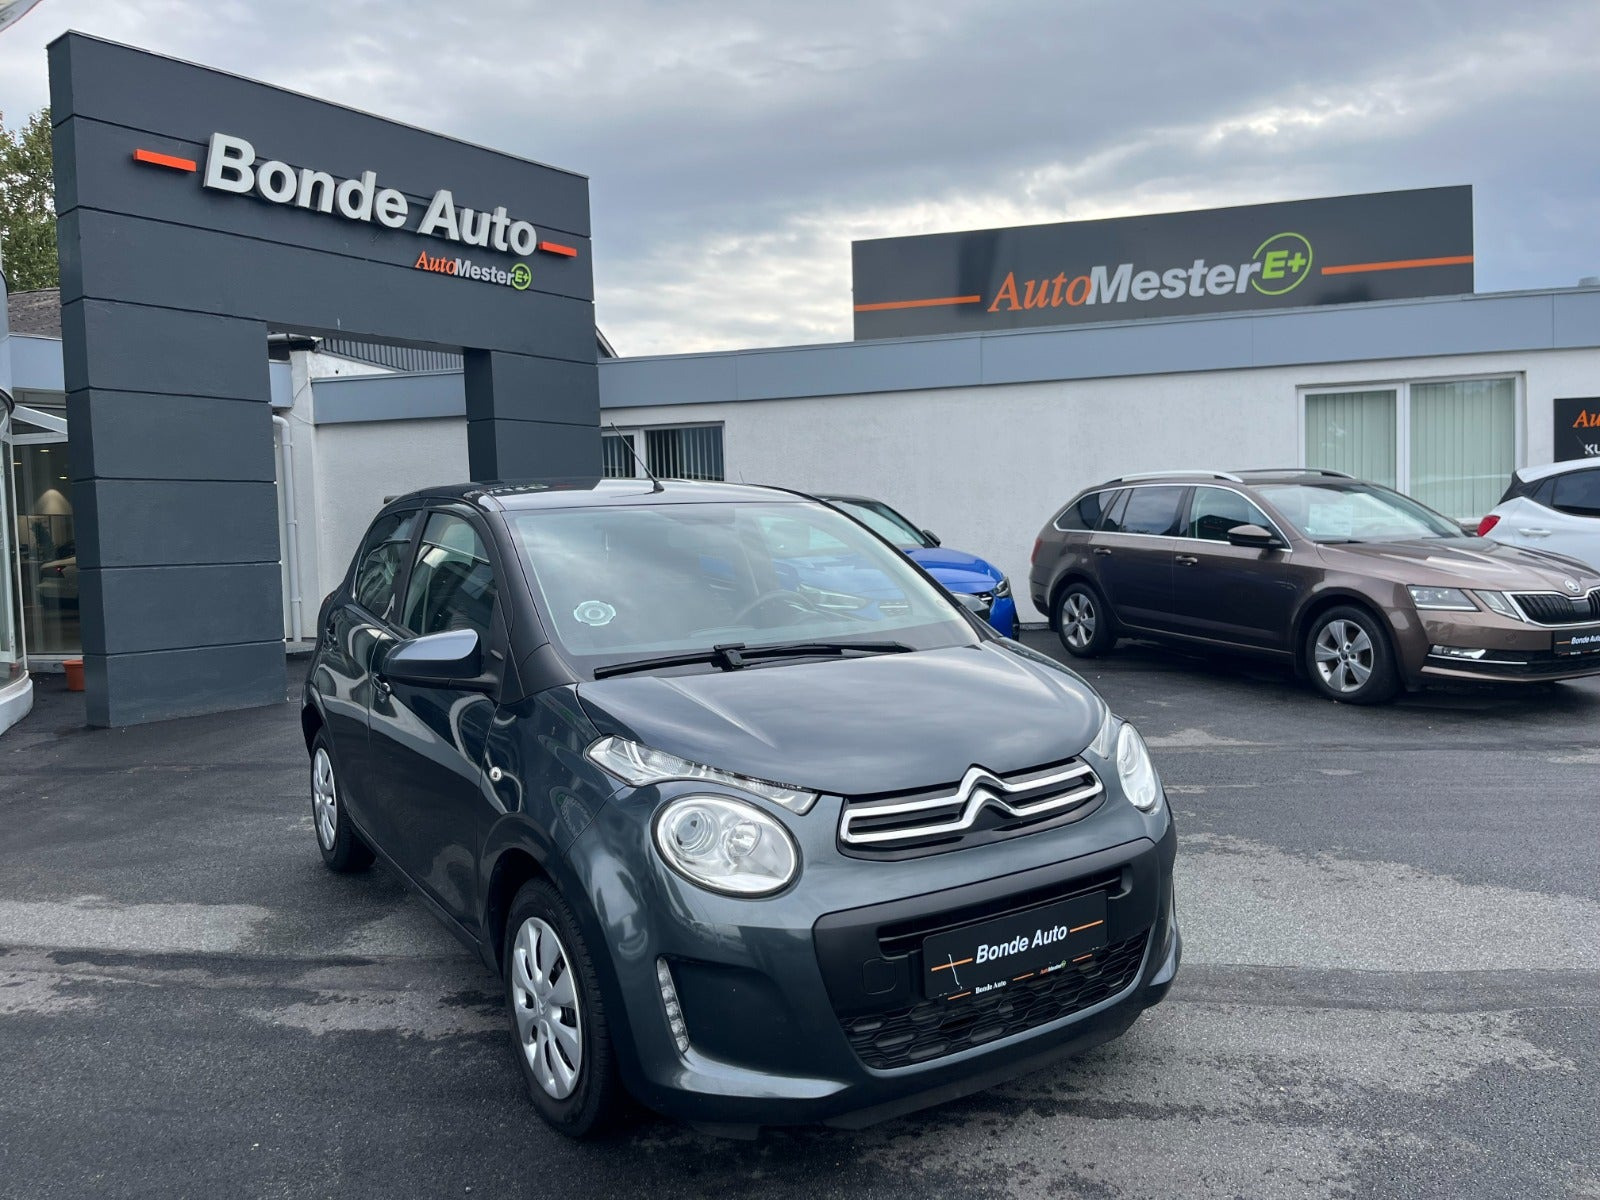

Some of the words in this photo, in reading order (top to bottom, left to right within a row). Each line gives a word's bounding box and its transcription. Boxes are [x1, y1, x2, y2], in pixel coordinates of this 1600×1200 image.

[203, 132, 409, 229] Bonde
[417, 189, 538, 257] Auto
[976, 935, 1029, 964] Bonde
[1031, 925, 1068, 948] Auto
[975, 983, 993, 994] Bonde
[993, 980, 1007, 989] Auto
